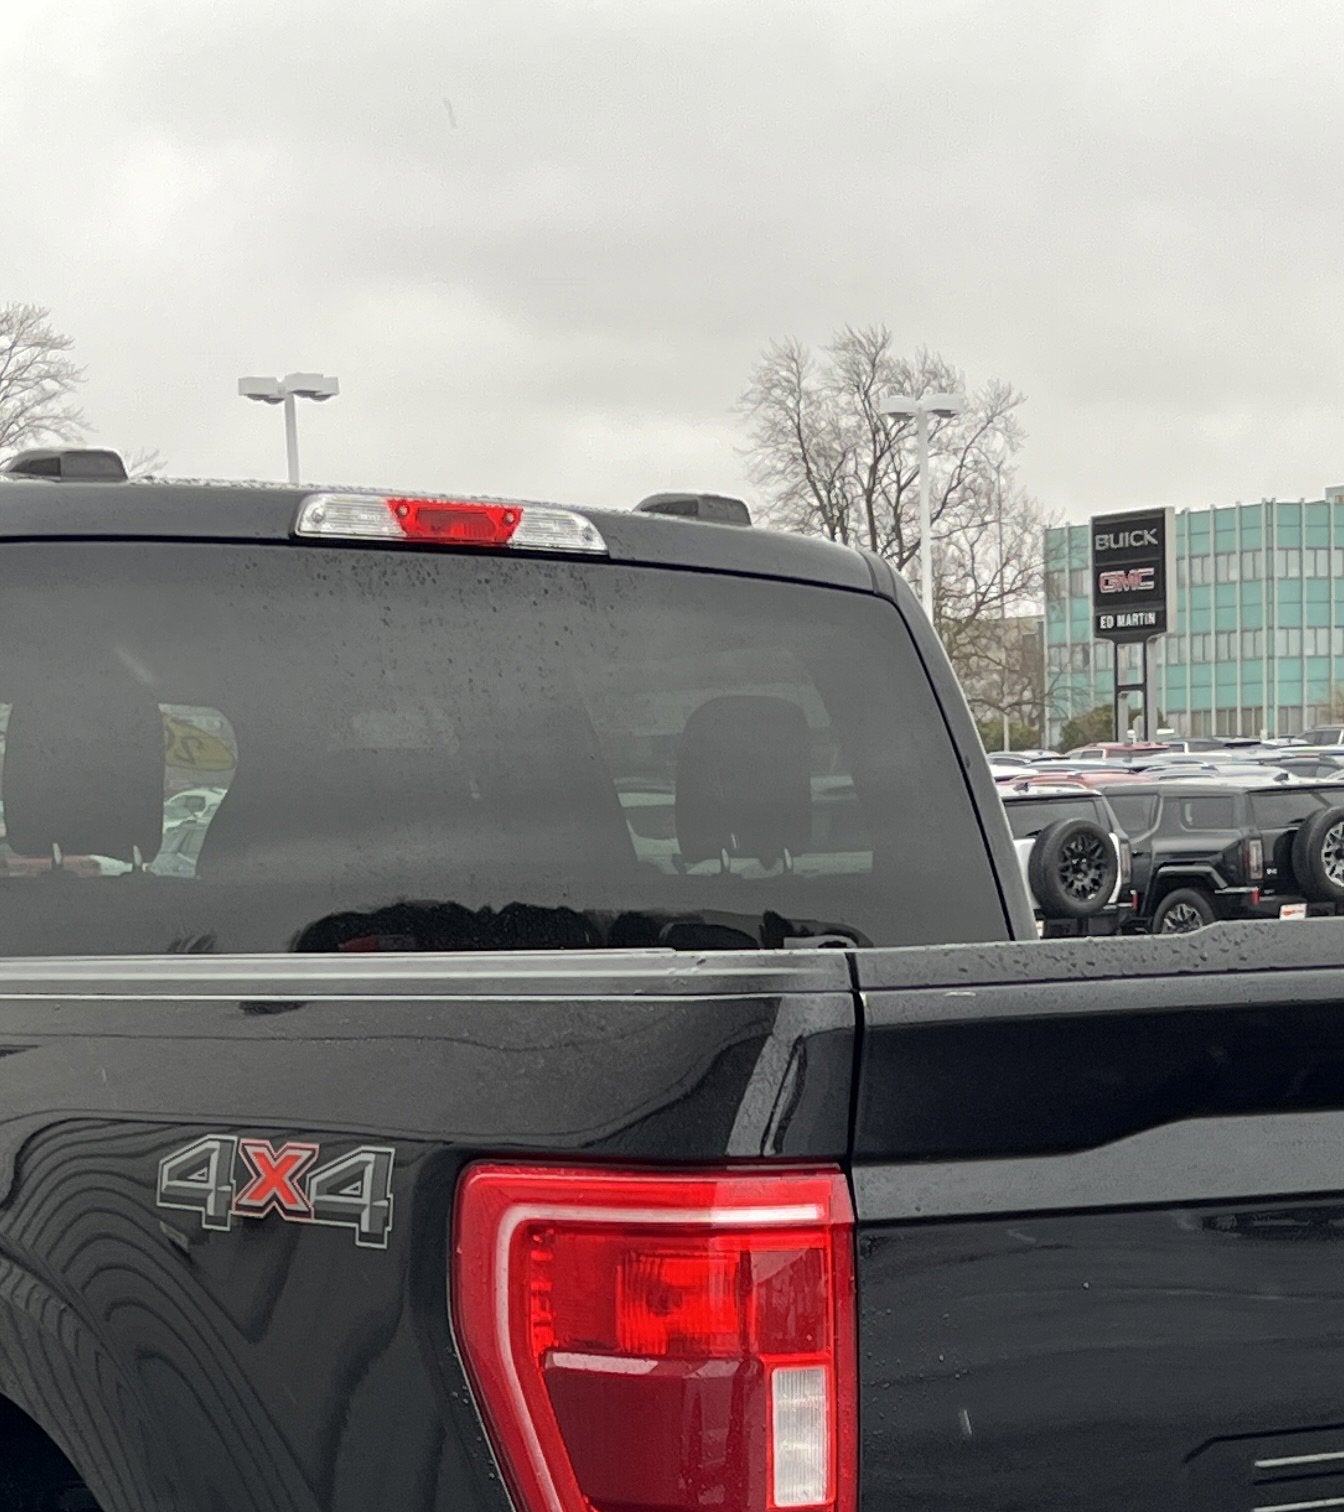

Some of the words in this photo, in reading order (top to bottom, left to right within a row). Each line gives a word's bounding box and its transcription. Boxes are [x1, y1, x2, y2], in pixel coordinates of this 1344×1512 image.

[1094, 528, 1159, 551] BUICK
[1099, 567, 1155, 593] GMC
[1100, 615, 1115, 629] ED
[1116, 612, 1156, 628] MARTIN
